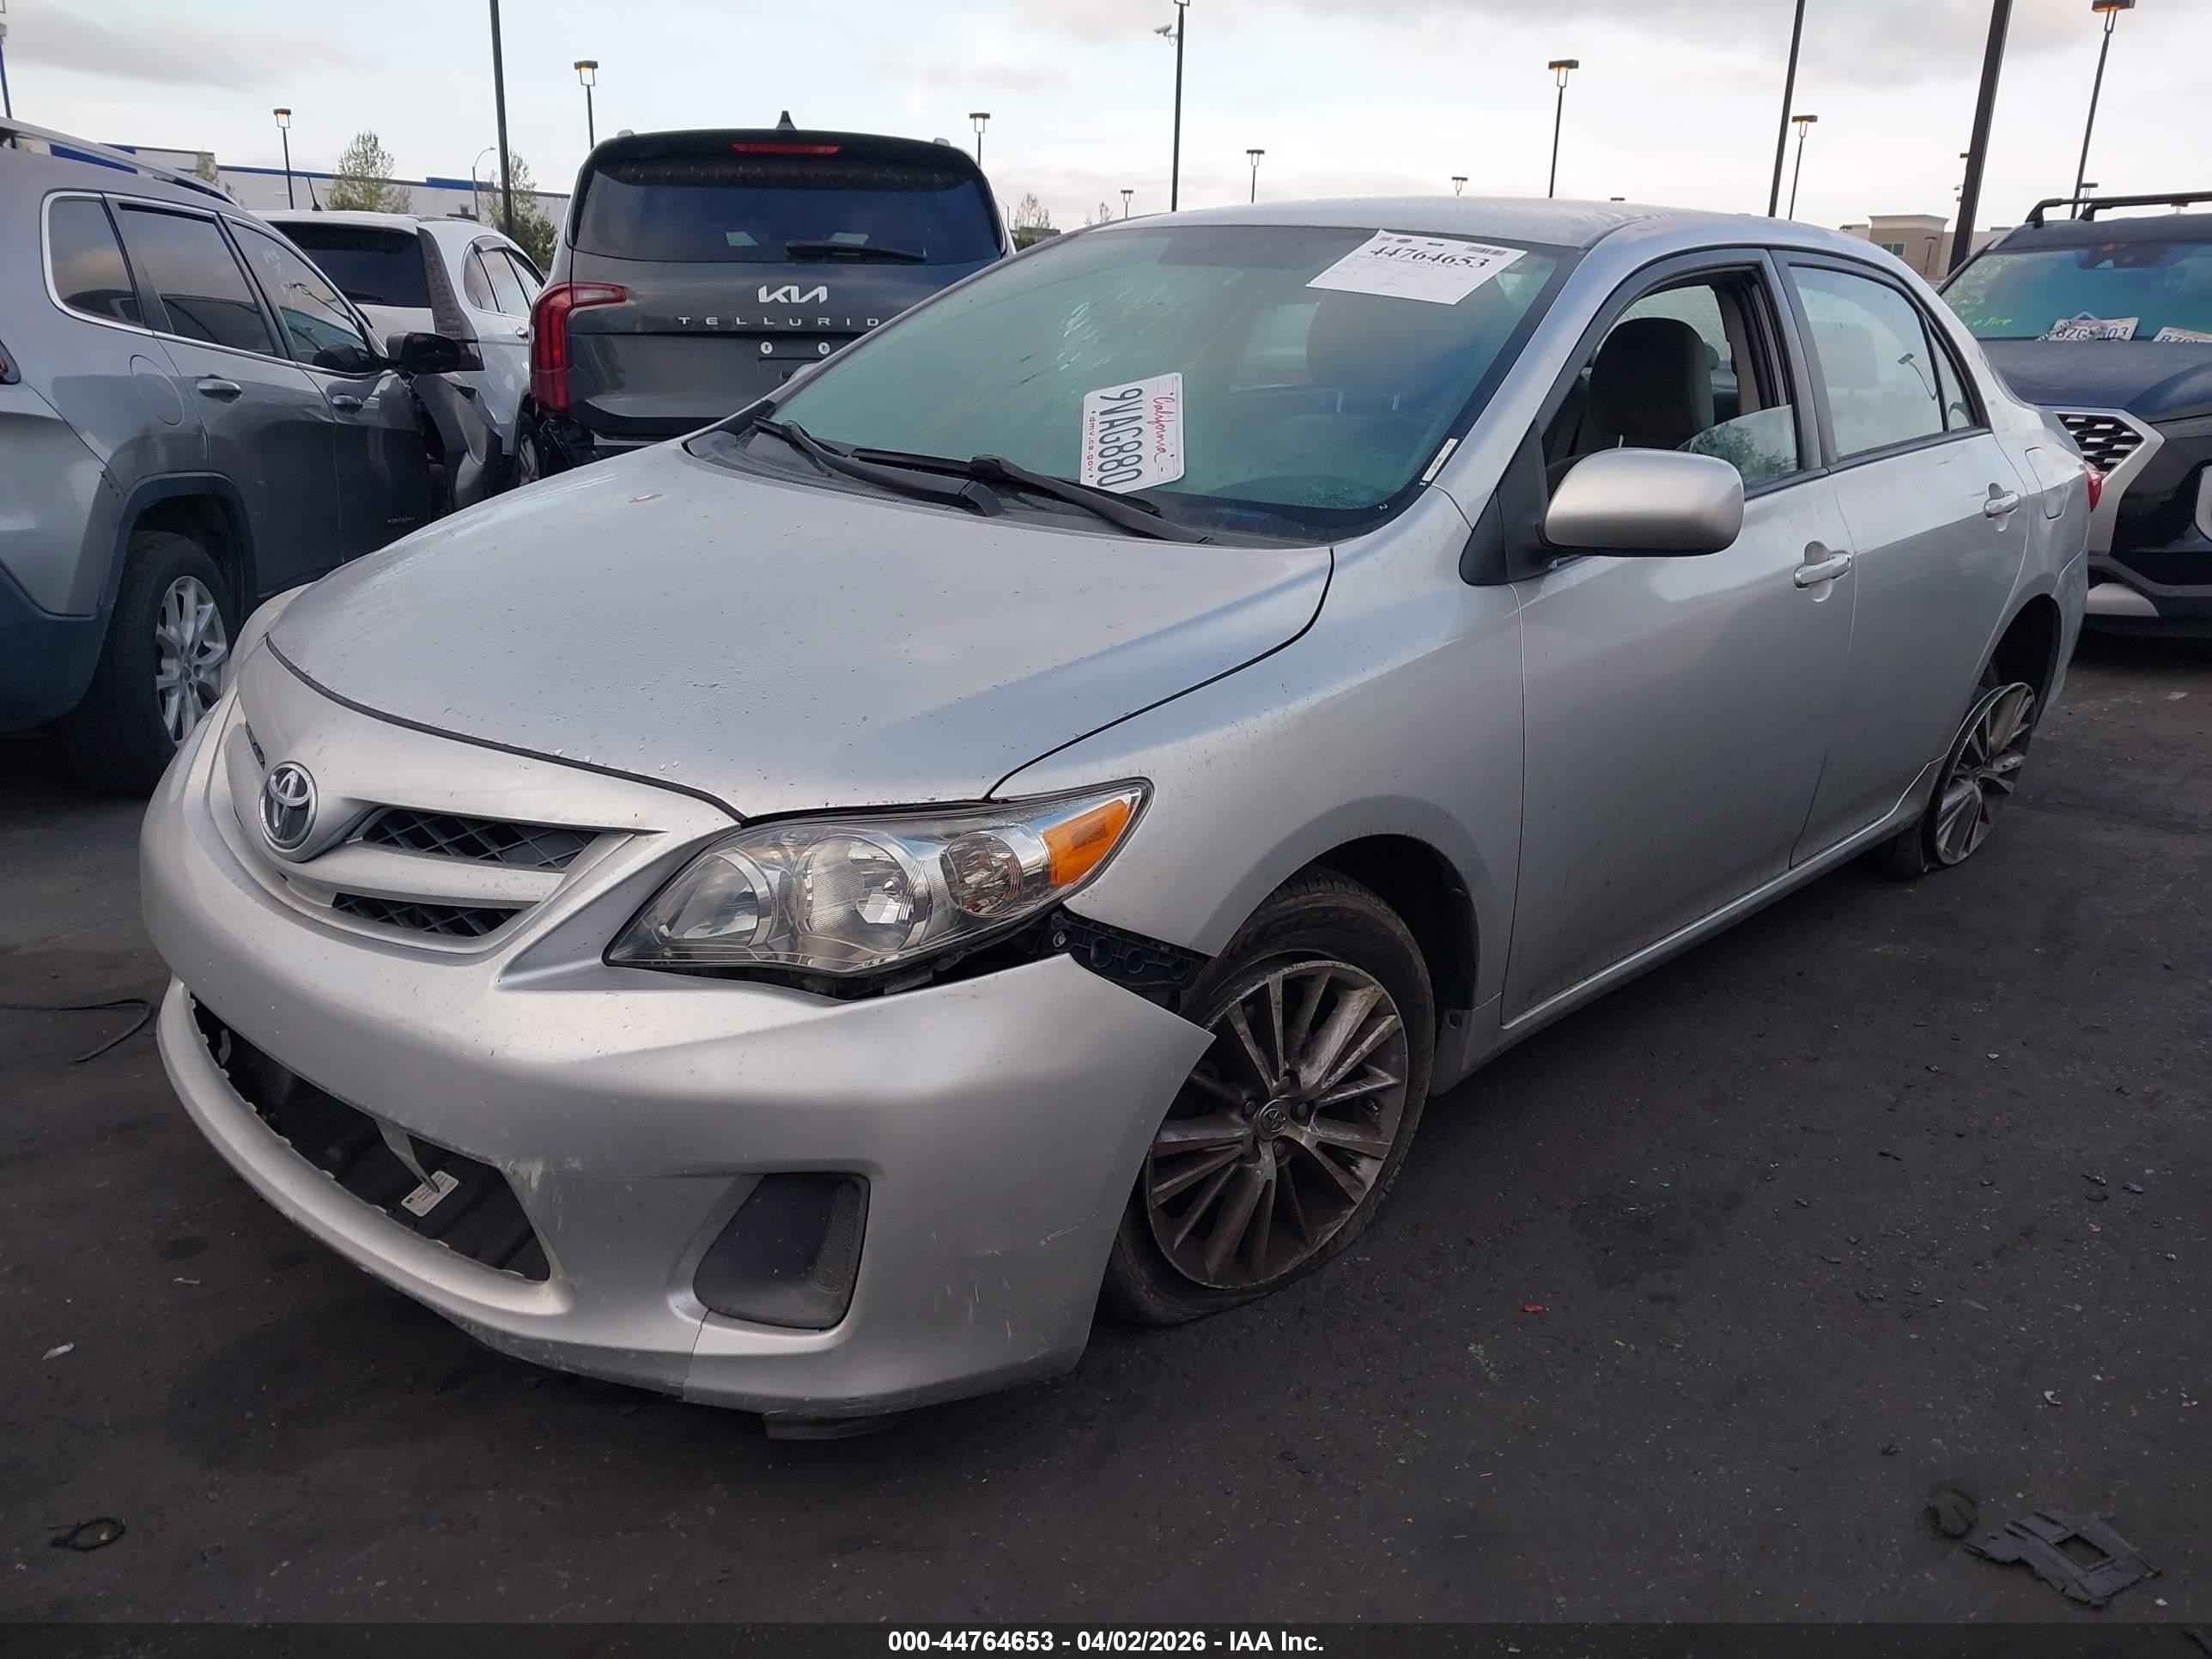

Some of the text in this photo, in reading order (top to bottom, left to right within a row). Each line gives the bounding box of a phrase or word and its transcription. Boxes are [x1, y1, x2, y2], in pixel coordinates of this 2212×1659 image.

[1370, 246, 1490, 268] 44764653
[757, 285, 828, 303] KIA
[678, 316, 879, 326] TELLURID
[1086, 416, 1096, 471] dmv.ca.gov
[1097, 387, 1144, 487] 9VAG880
[1146, 397, 1176, 463] California
